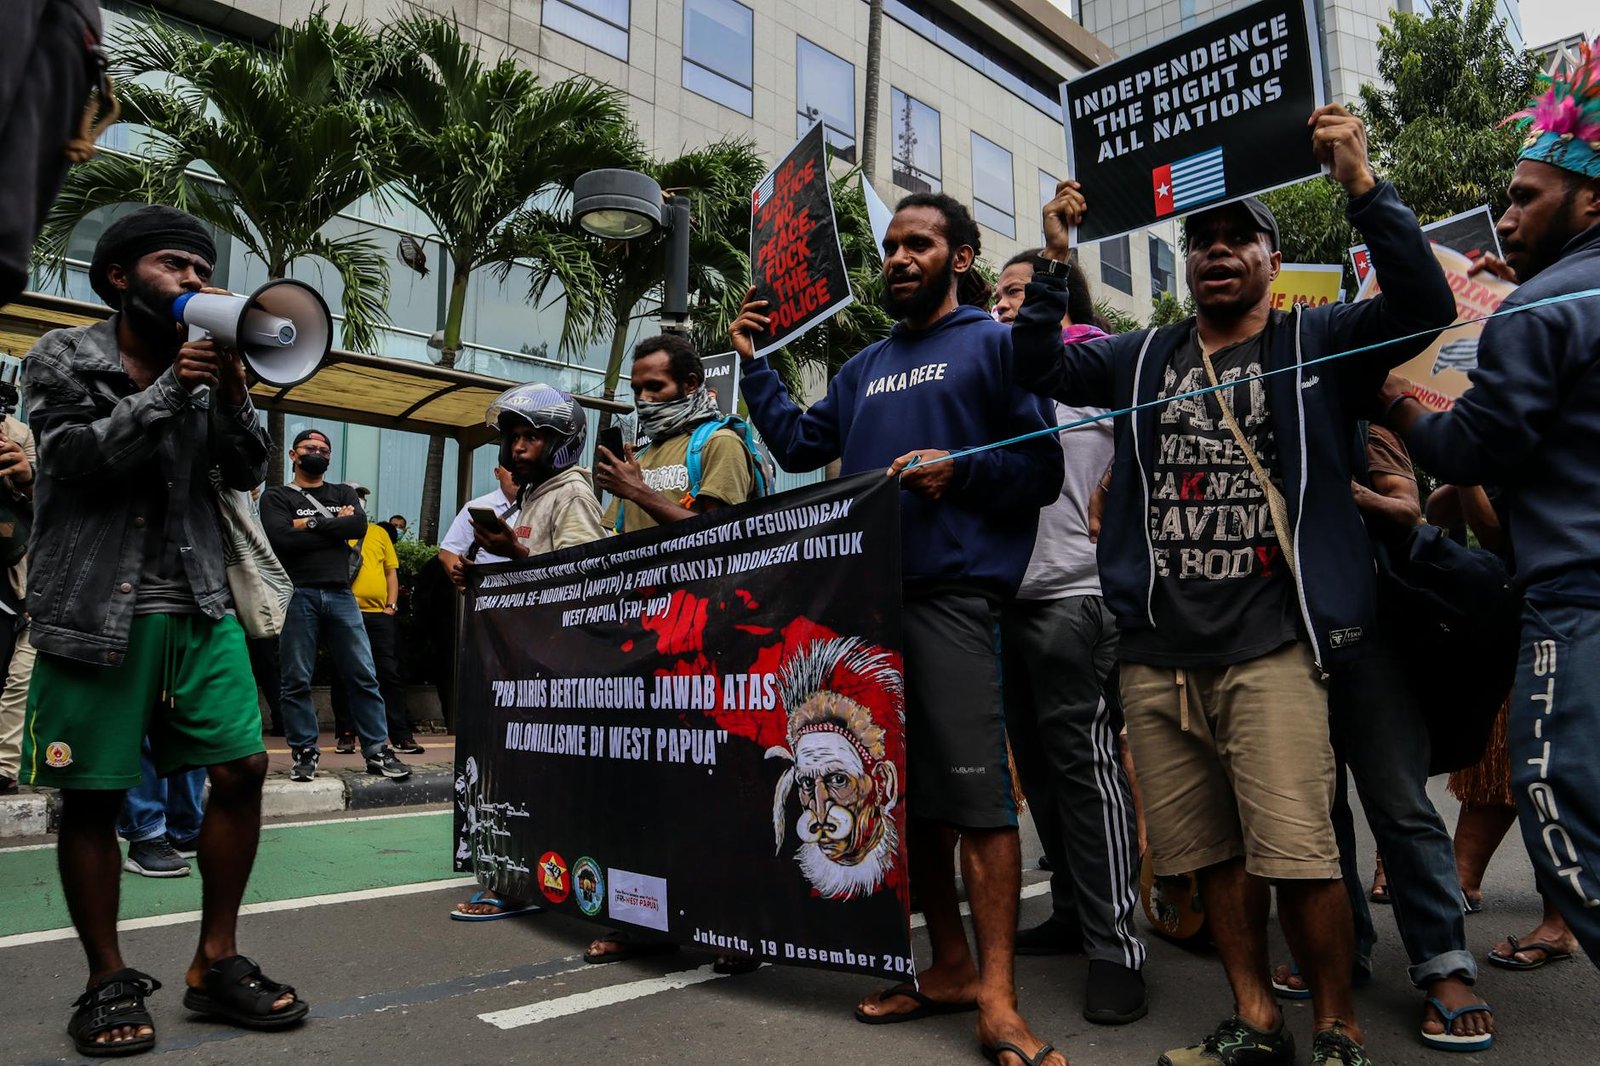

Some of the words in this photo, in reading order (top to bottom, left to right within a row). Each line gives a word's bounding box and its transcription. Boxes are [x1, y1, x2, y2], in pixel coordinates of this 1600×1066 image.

[1074, 13, 1288, 119] INDEPENDENCE
[1093, 101, 1143, 138] THE
[1153, 63, 1238, 116] RIGHT
[1250, 44, 1288, 79] OF
[1097, 130, 1144, 164] ALL
[1153, 77, 1283, 143] NATIONS
[757, 159, 816, 230] JUSTICE
[775, 159, 795, 188] NO
[773, 200, 794, 232] NO
[765, 233, 811, 284] FUCK
[773, 264, 811, 301] THE
[768, 277, 831, 336] POLICE
[704, 364, 730, 379] UAN
[660, 520, 742, 553] MAHASISWA
[745, 498, 853, 538] PEGUNUNGAN
[496, 592, 526, 608] PAPUA
[525, 583, 582, 607] SE-INDONESIA
[583, 571, 624, 602] (AMPTPI)
[625, 573, 633, 590] &
[633, 565, 668, 589] FRONT
[670, 556, 724, 584] RAKYAT
[726, 541, 799, 575] INDONESIA
[803, 531, 864, 560] UNTUK
[1179, 546, 1279, 580] BODY
[562, 610, 584, 628] WEST
[584, 605, 617, 624] PAPUA
[619, 592, 672, 624] (FRI-WP)
[549, 676, 645, 710] BERTANGGUNG
[650, 674, 716, 711] JAWAB
[722, 672, 777, 711] ATAS
[505, 722, 586, 757] KOLONIALISME
[590, 725, 604, 758] DI
[608, 726, 651, 762] WEST
[656, 728, 729, 765] PAPUA"
[693, 927, 754, 956] Jakarta,
[760, 939, 778, 956] 19
[784, 942, 876, 968] Desember
